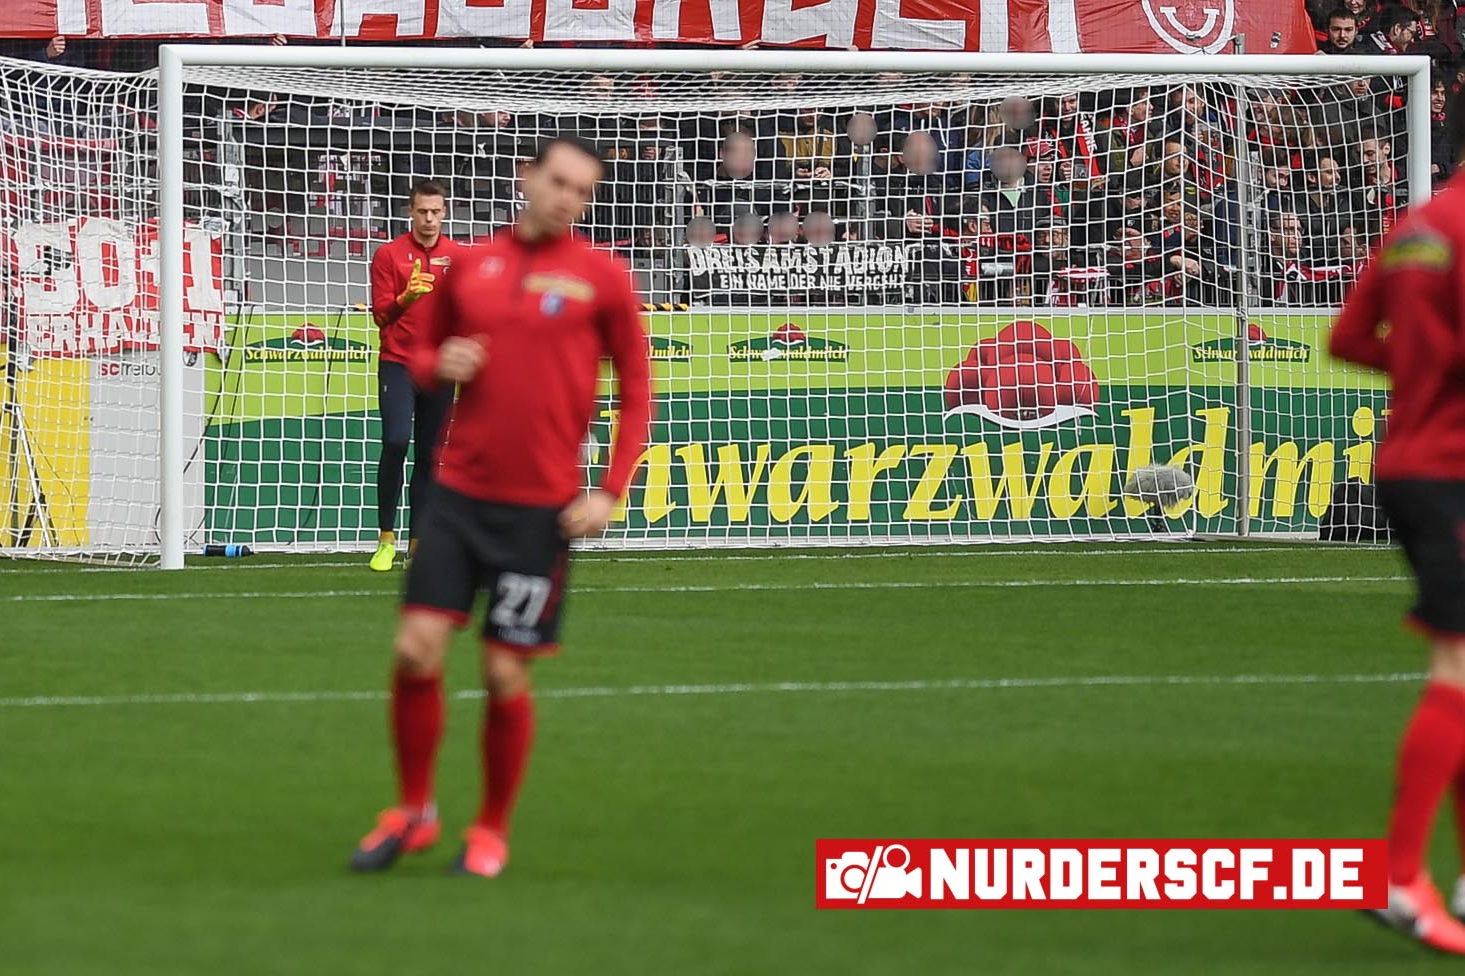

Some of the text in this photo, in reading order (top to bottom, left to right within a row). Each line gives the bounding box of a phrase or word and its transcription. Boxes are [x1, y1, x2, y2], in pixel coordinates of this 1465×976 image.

[688, 245, 911, 277] DREISAMSTADION
[720, 274, 744, 290] EIN
[747, 274, 786, 290] NAME
[790, 274, 817, 289] DER
[820, 274, 843, 291] NIE
[490, 571, 552, 628] 27
